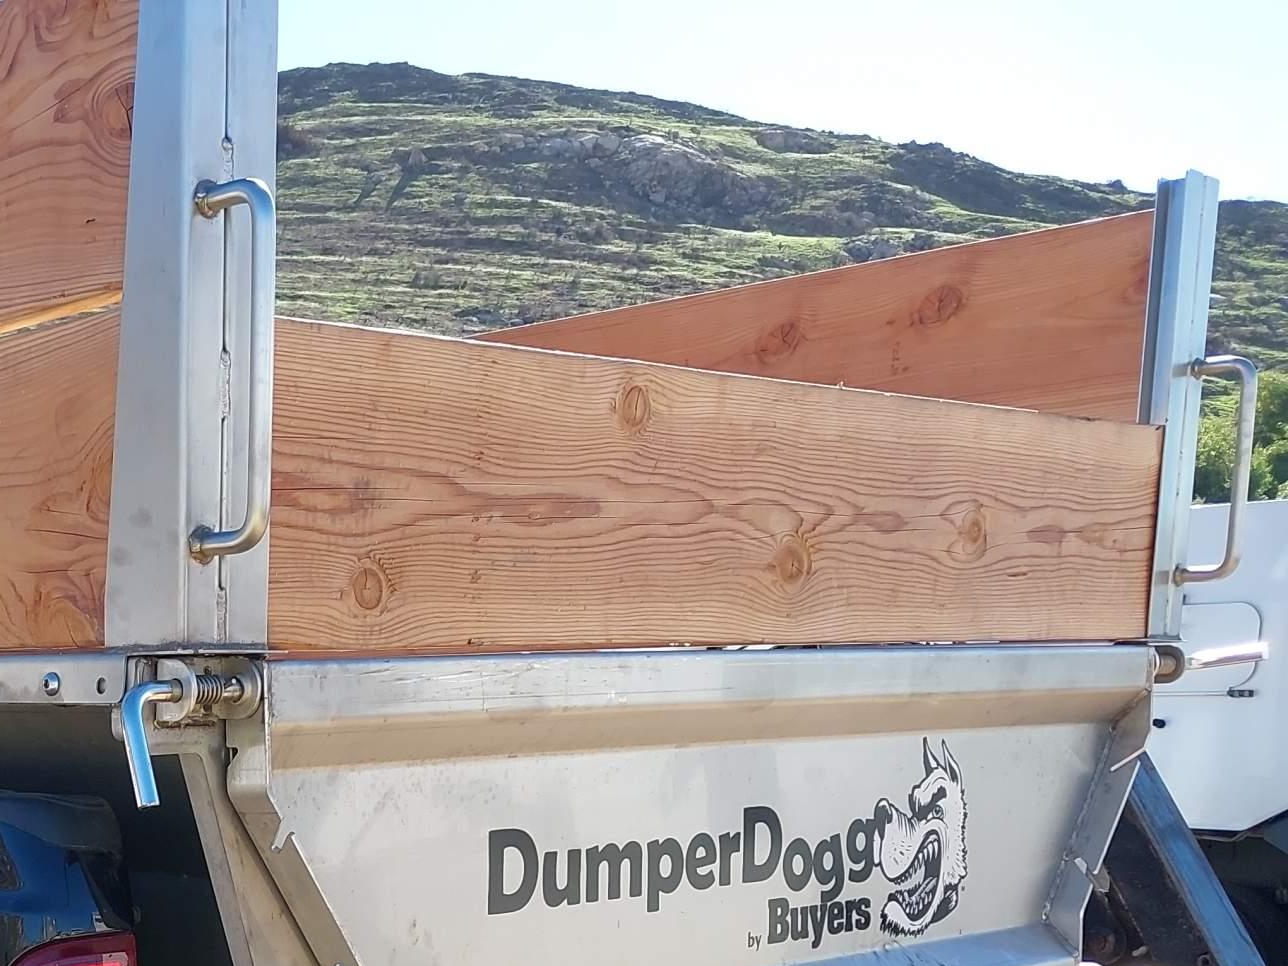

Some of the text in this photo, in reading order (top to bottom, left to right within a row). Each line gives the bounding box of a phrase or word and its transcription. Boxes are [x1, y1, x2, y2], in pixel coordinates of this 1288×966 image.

[487, 805, 877, 916] DumperDogg
[747, 897, 872, 951] by Buyers
